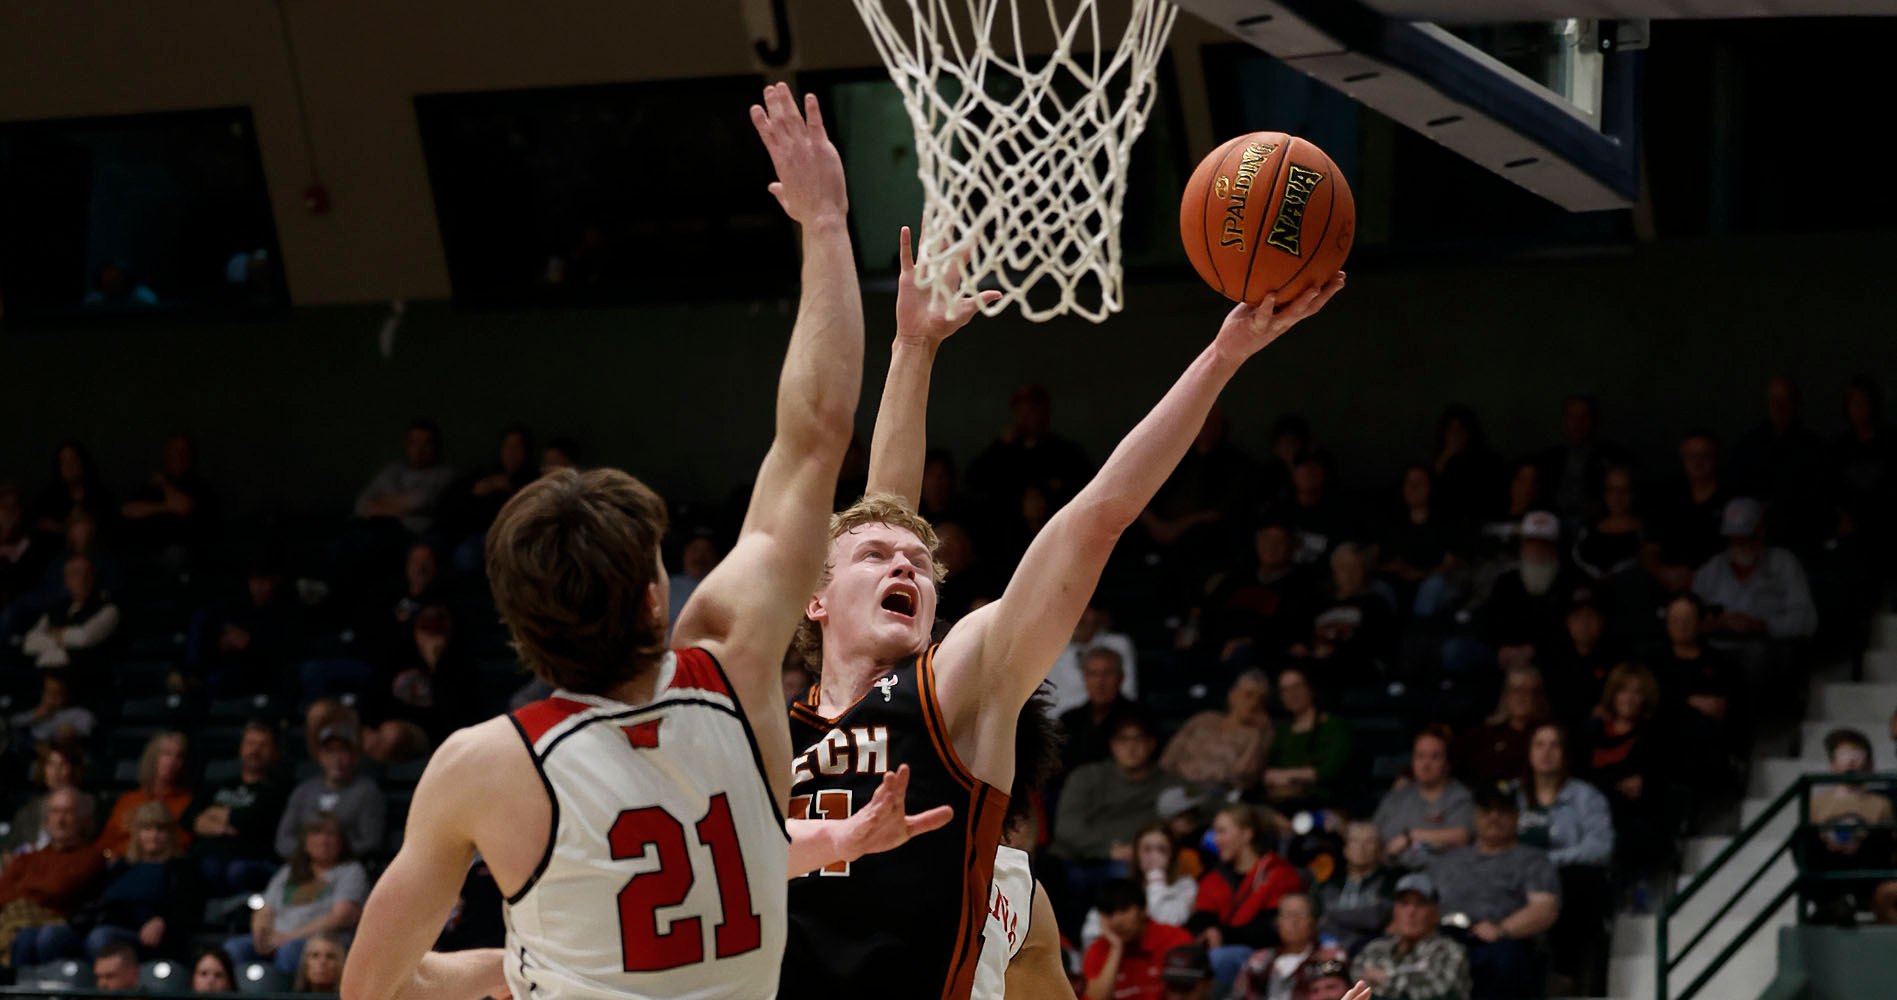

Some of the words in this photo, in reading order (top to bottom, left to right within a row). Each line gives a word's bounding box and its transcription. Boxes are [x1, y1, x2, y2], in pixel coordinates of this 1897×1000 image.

[1219, 142, 1277, 252] SPALDING
[1265, 164, 1324, 257] NAIA
[607, 791, 762, 973] 21
